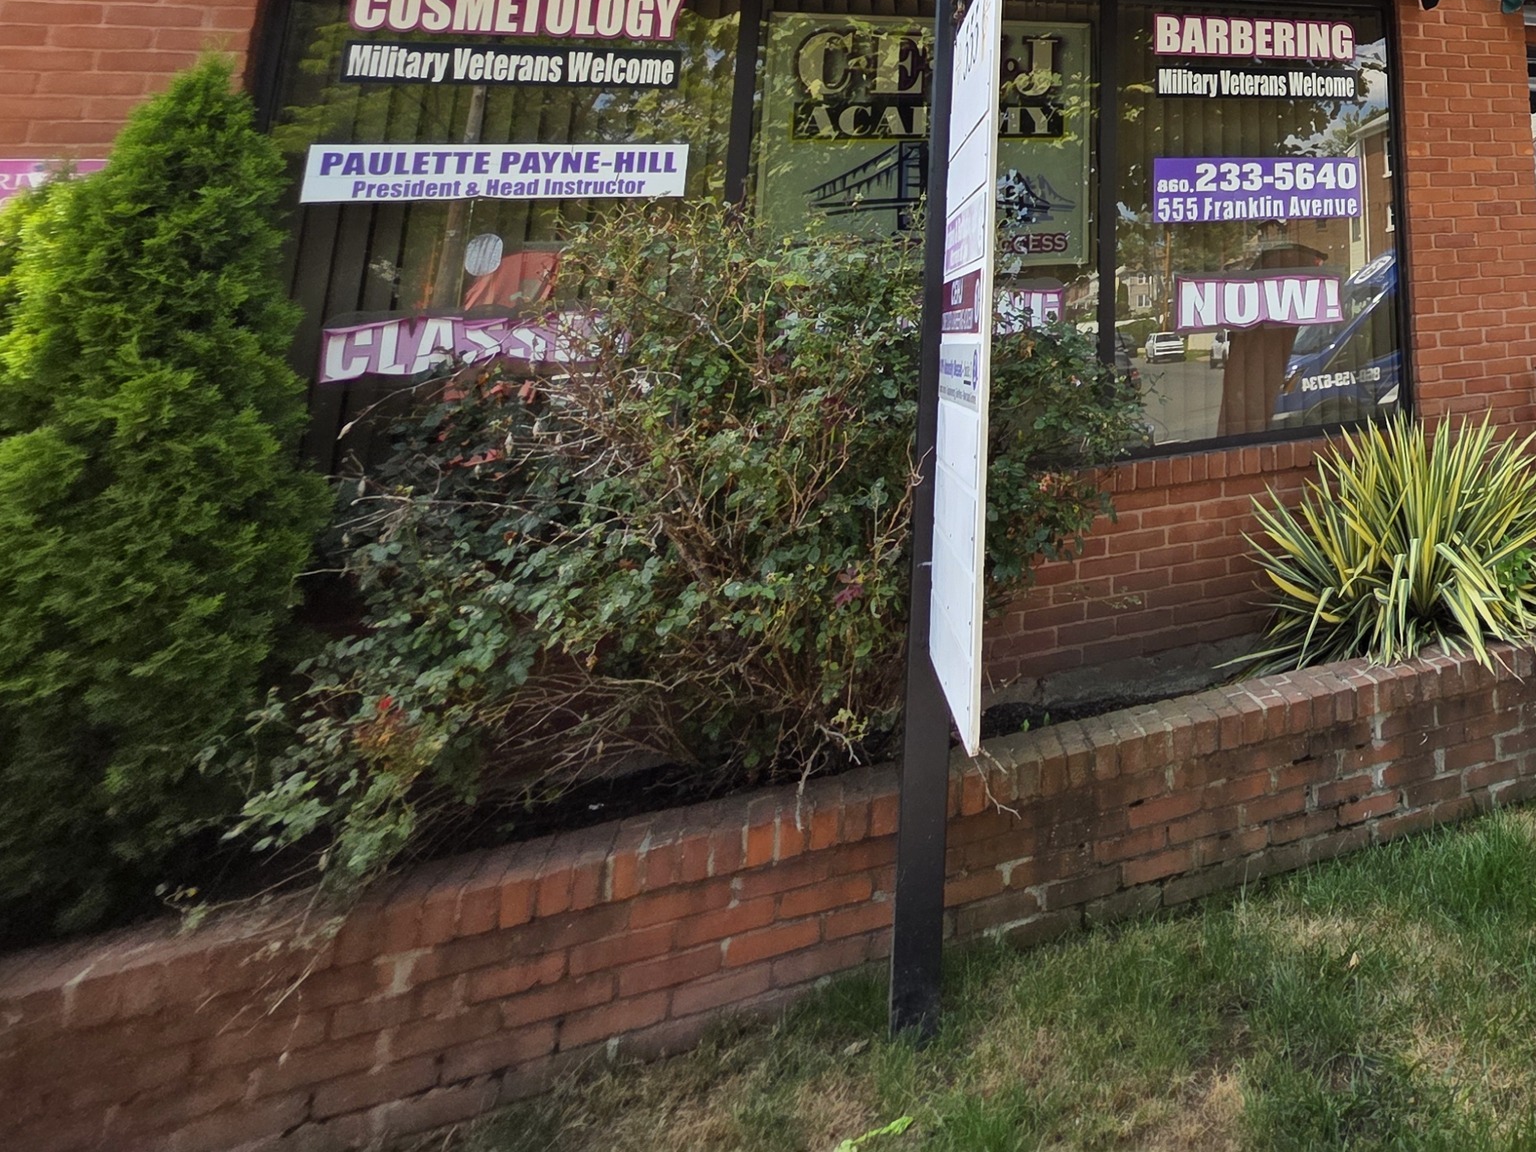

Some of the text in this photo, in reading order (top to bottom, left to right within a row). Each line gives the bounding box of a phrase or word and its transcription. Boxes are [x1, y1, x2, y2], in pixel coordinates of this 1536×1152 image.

[1156, 16, 1354, 60] BARBERING
[346, 45, 675, 85] Military Veterans Welcome
[1159, 70, 1355, 98] Military Veterans Welcome
[320, 151, 677, 176] PAULETTE PAYNE-HILL
[351, 177, 645, 199] President & Head Instructor
[1157, 196, 1357, 222] 555 Franklin Avenue
[1181, 279, 1340, 327] NOW!
